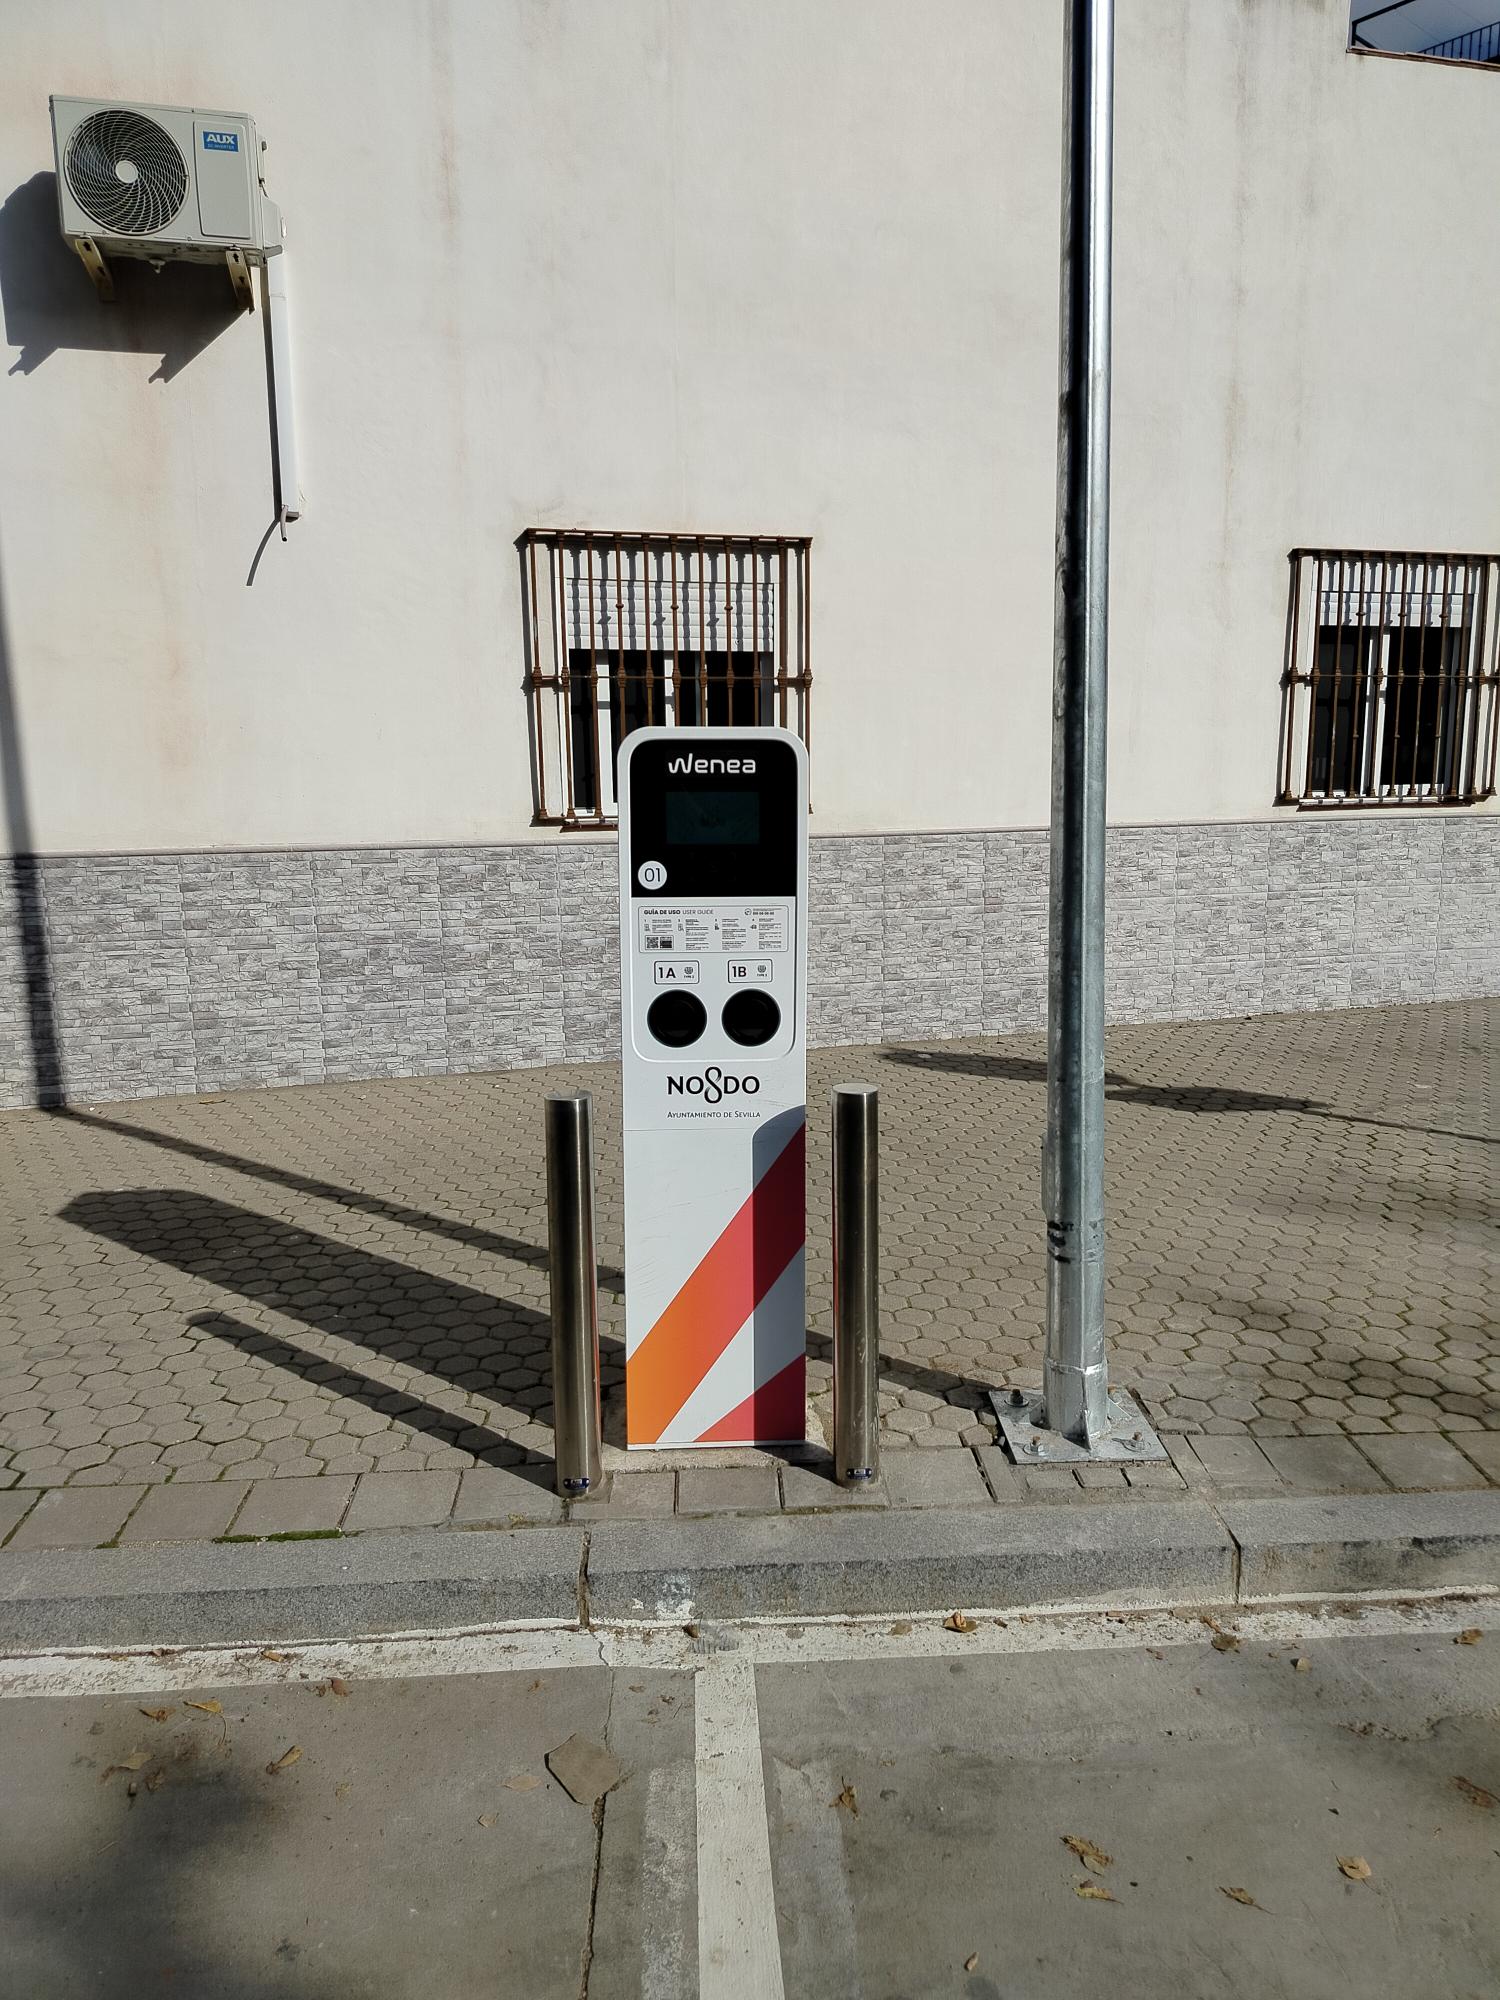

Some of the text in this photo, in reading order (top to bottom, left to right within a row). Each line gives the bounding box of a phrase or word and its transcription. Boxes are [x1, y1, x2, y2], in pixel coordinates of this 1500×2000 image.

[207, 134, 236, 144] AUX
[668, 753, 756, 774] Wenea
[644, 867, 661, 882] 01
[732, 966, 747, 978] 1B
